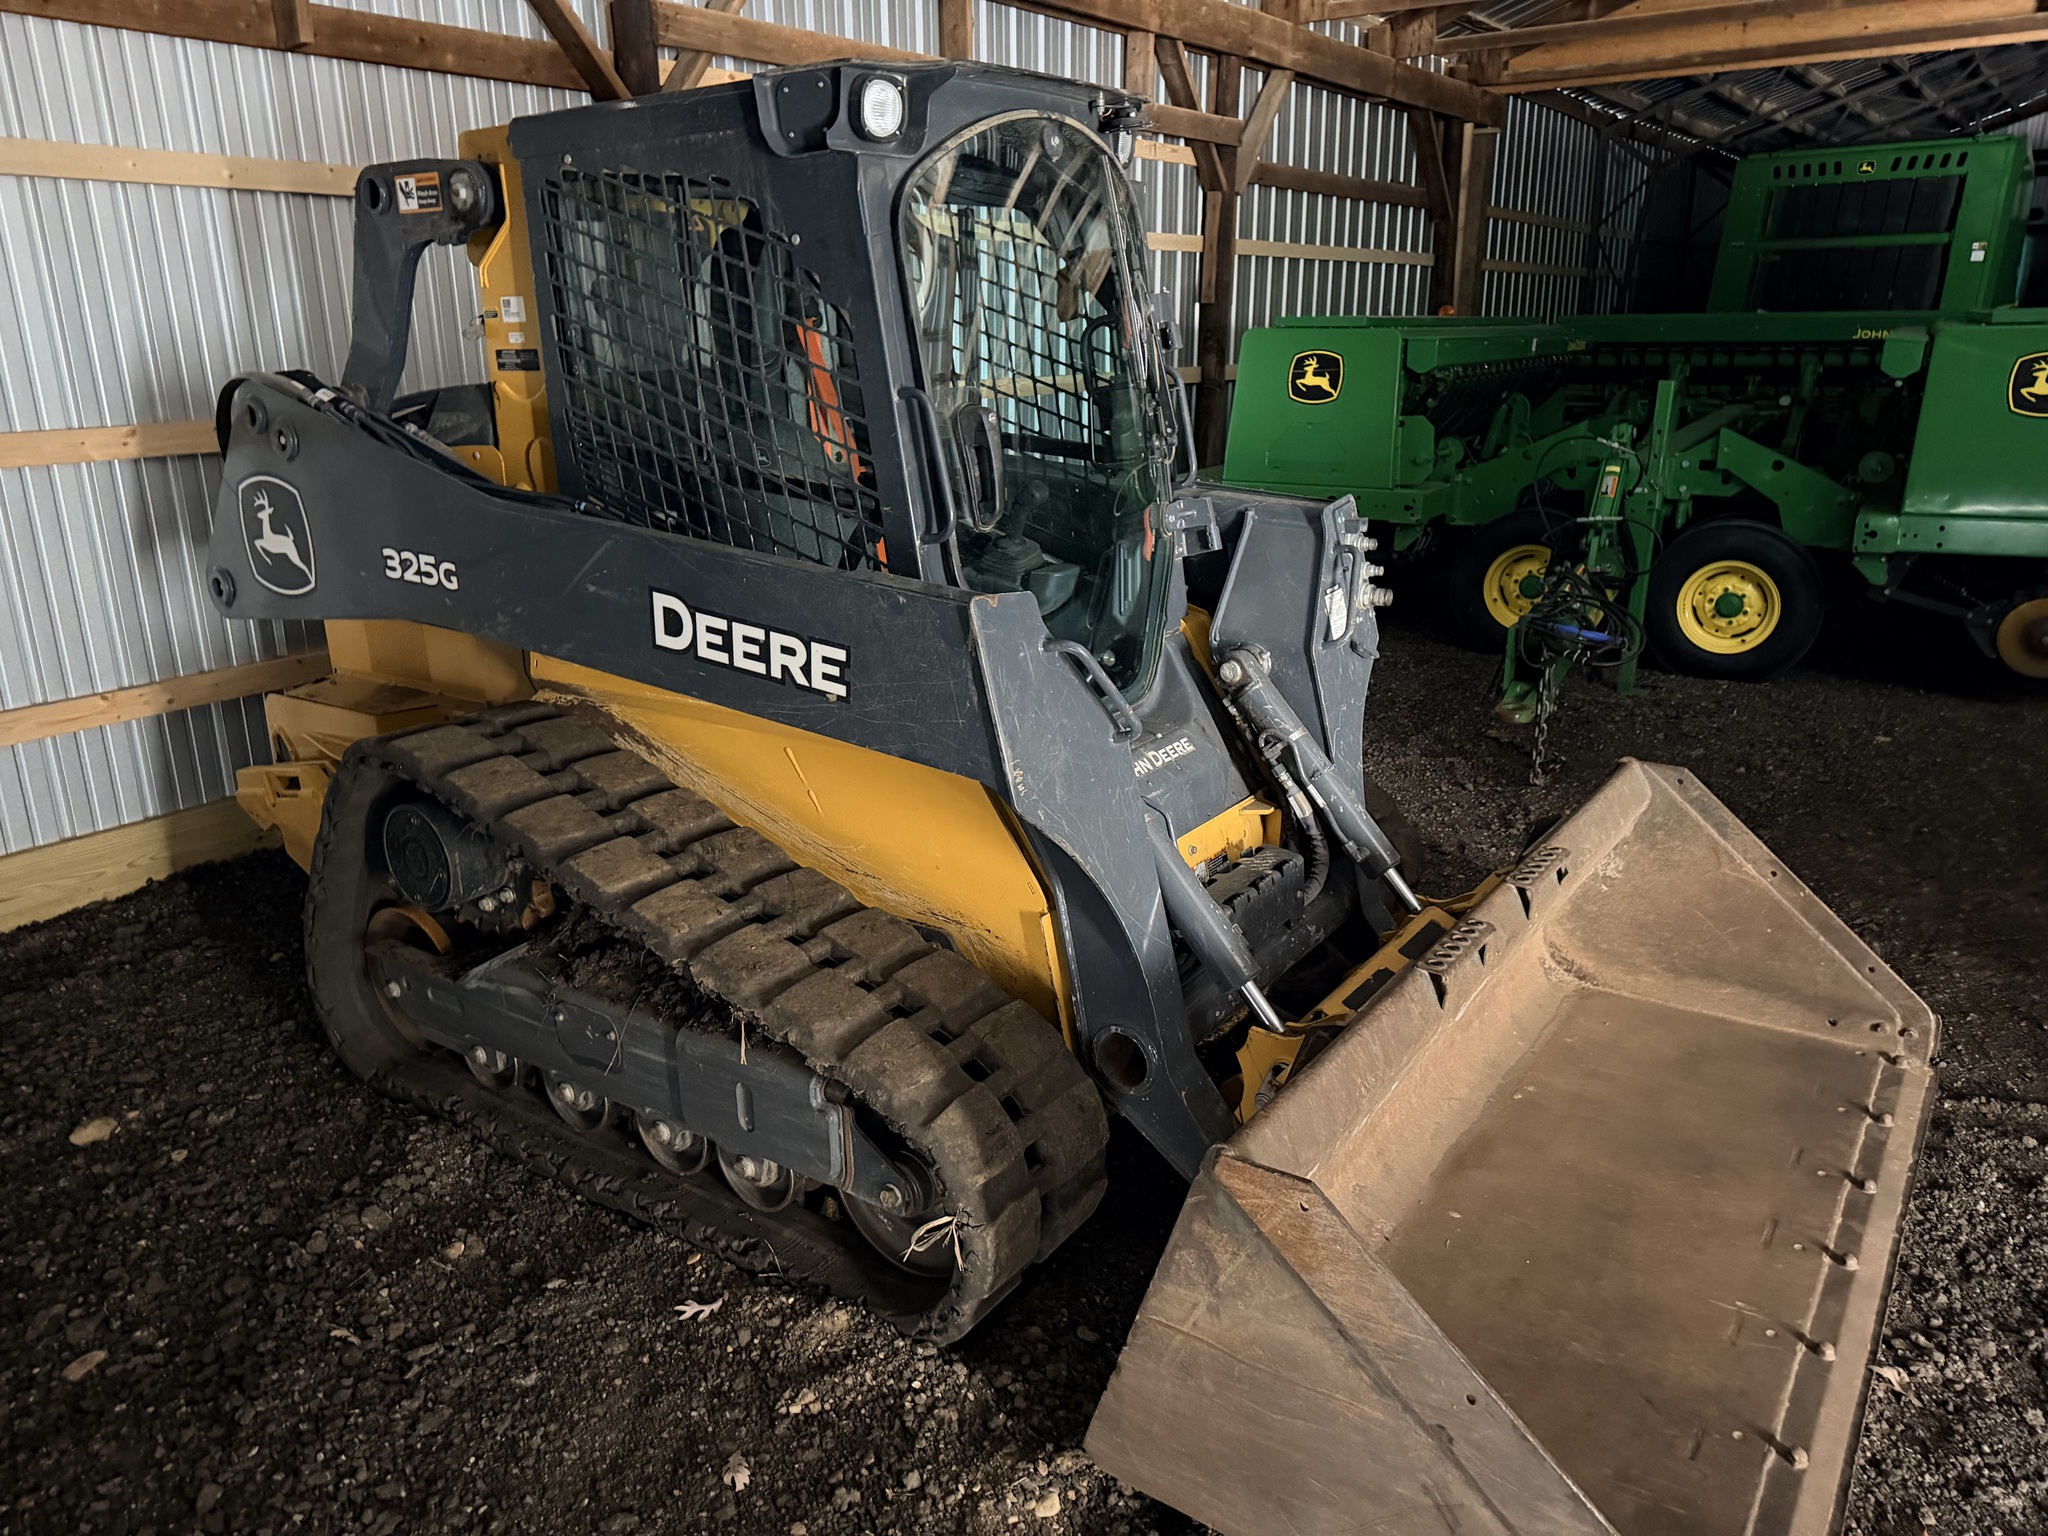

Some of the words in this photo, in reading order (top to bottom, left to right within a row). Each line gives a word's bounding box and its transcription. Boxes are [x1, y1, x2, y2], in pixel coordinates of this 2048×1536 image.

[382, 547, 459, 591] 325G
[652, 591, 848, 698] DEERE
[1132, 757, 1154, 778] HN
[1146, 737, 1197, 768] DEERE
